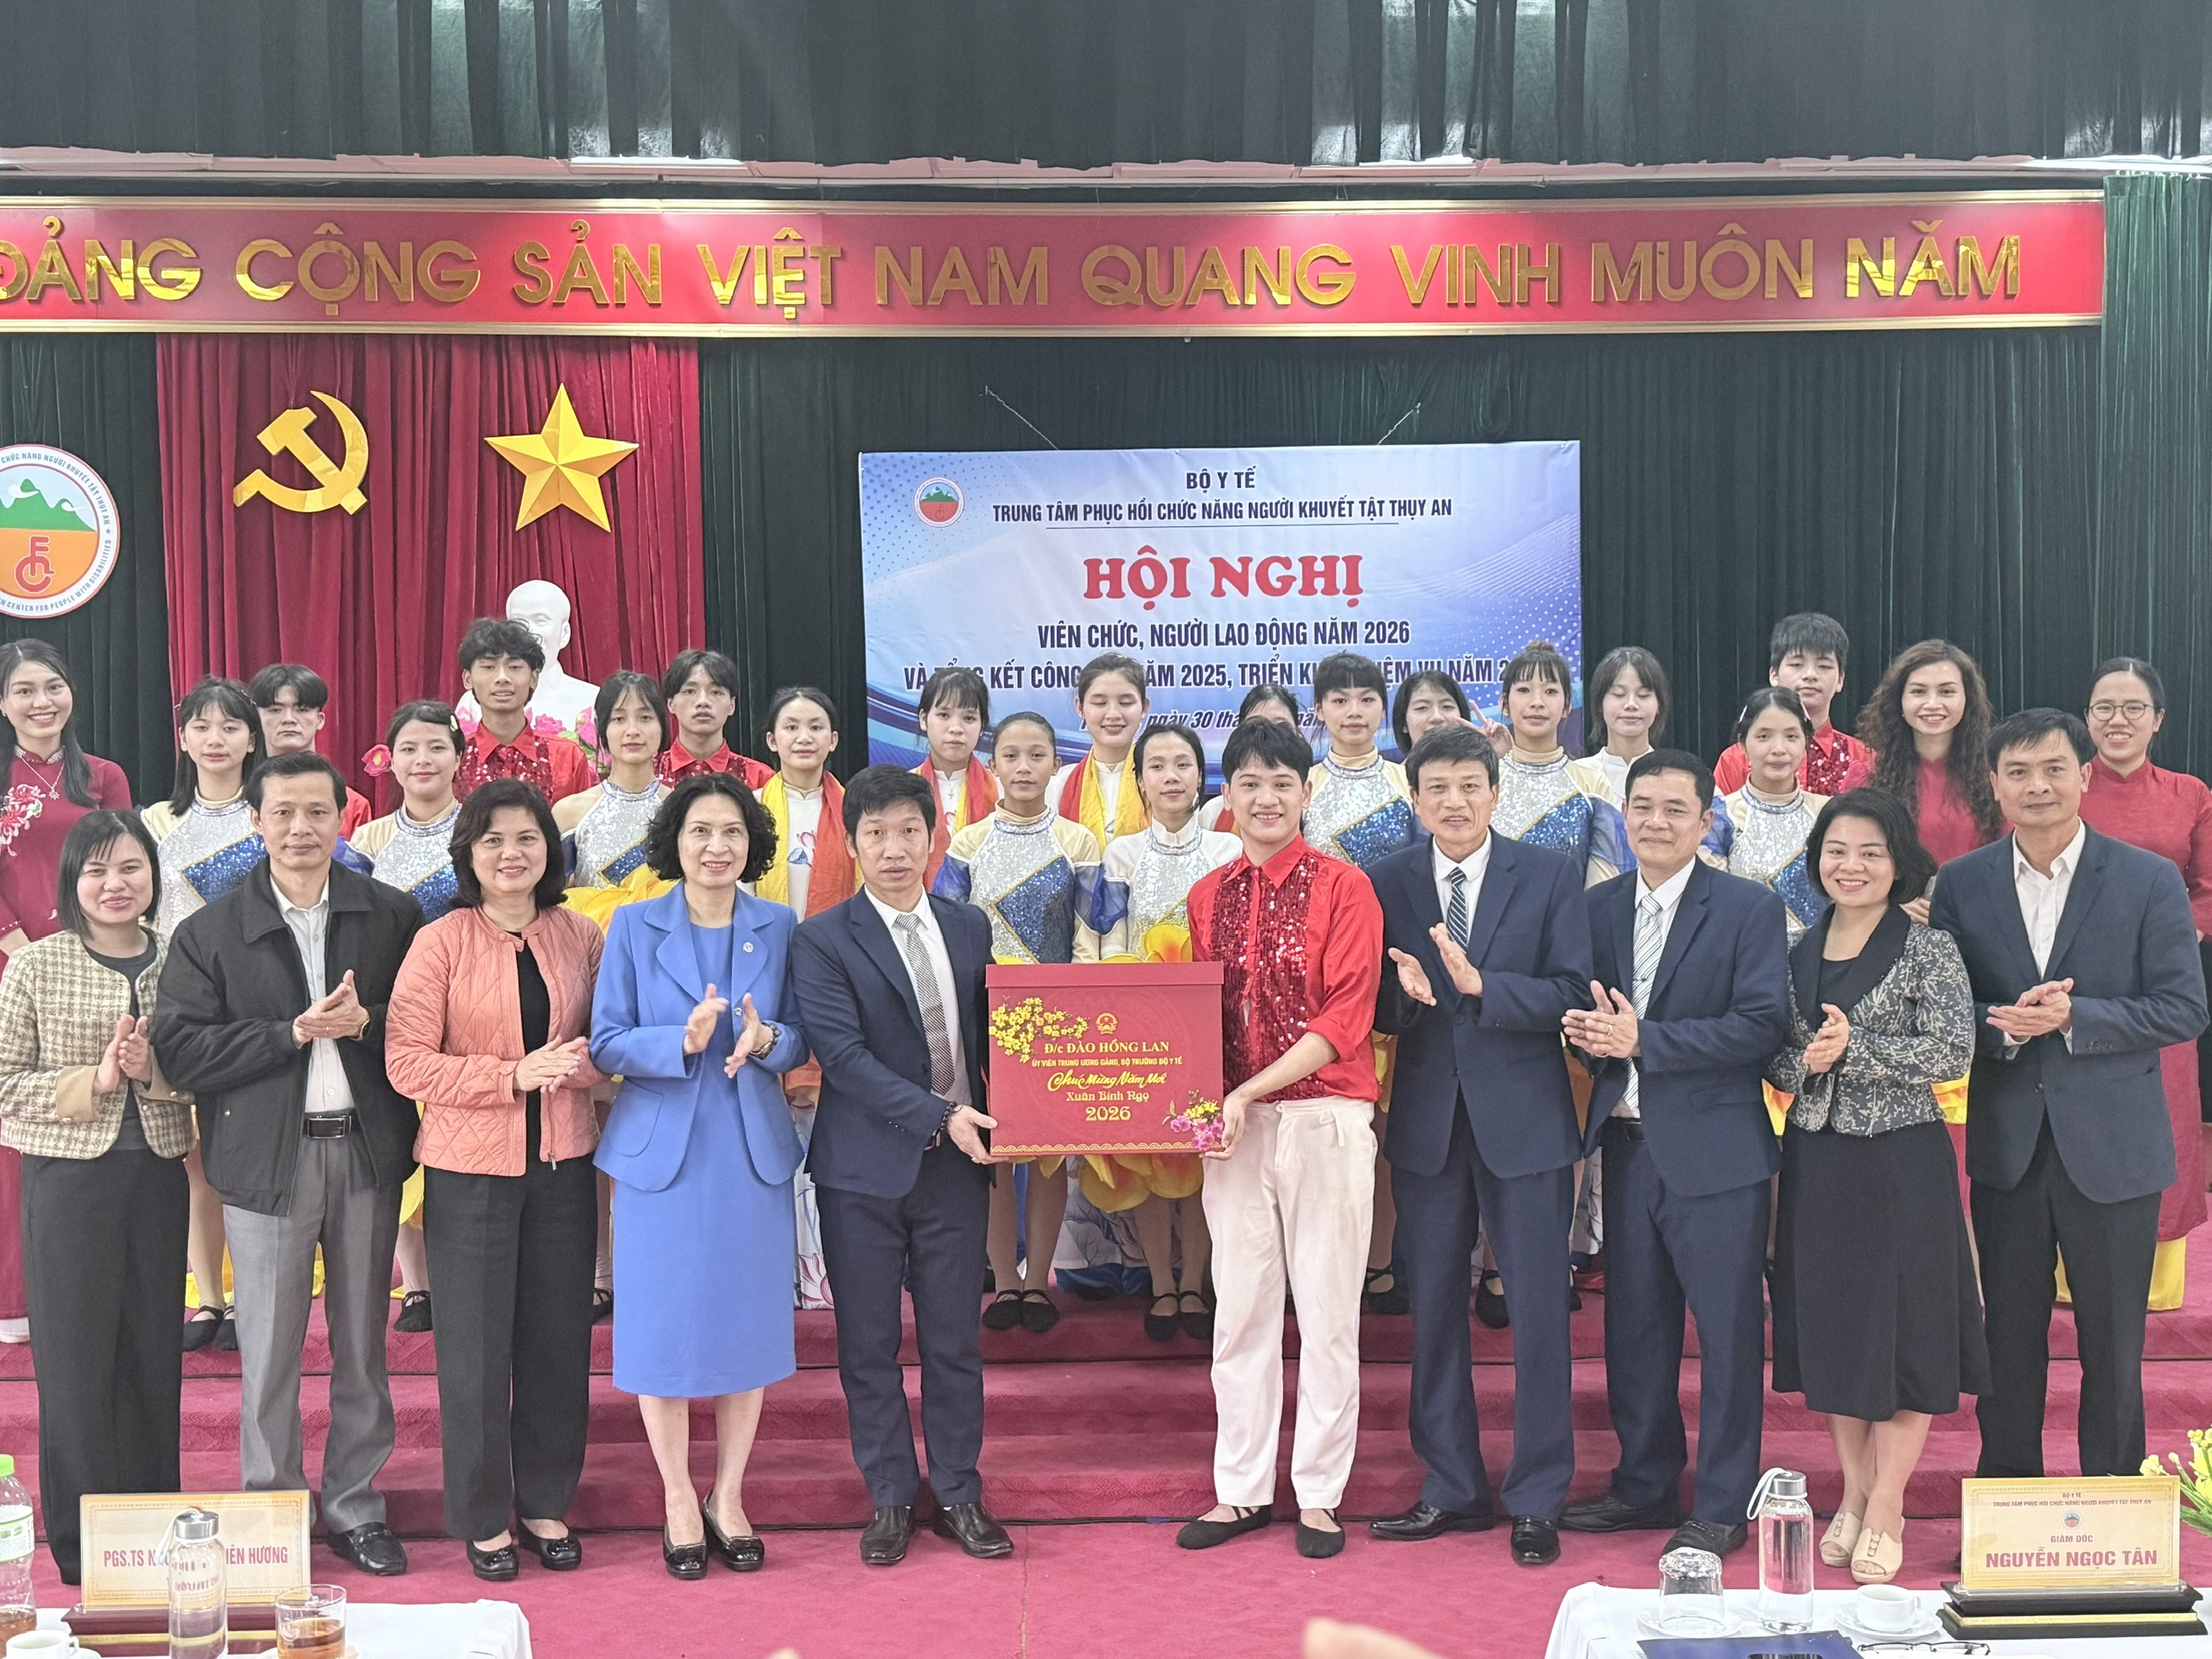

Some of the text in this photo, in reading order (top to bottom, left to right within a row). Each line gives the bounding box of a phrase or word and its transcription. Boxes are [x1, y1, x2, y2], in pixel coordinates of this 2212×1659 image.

[236, 222, 482, 316] CỘNG
[514, 219, 663, 305] SẢN
[696, 226, 842, 320] VIỆT
[874, 245, 1048, 307] NAM
[1081, 245, 1356, 308] QUANG
[1391, 243, 1559, 306] VINH
[1592, 222, 1814, 302] MUÔN
[1846, 219, 2021, 297] NĂM
[1185, 465, 1257, 493] BỘ Y TẾ
[102, 515, 111, 524] AN
[993, 495, 1452, 524] TRUNG TÂM PHỤC HỒI CHỨC NĂNG NGƯỜI KHUYẾT TẬT THỤY AN
[1084, 544, 1364, 611] HỘI NGHỊ
[50, 594, 75, 609] PEOPLE
[1038, 617, 1410, 651] VIÊN CHỨC, NGƯỜI LAO ĐỘNG NĂM 2026
[904, 663, 927, 690] VÀ
[991, 659, 1025, 689] KẾT
[1143, 660, 1175, 687] ĂM
[1181, 664, 1232, 689] 2025,
[1238, 654, 1294, 686] TRIỂN
[1449, 654, 1493, 683] NĂM
[1191, 711, 1214, 728] 30
[1045, 1039, 1170, 1054] Đ/c ĐÀO HỒNG LAN
[1047, 1069, 1090, 1091] Chúc
[1116, 1071, 1146, 1089] Năm
[1066, 1090, 1150, 1103] Xuân Bính Ngọ
[1085, 1106, 1131, 1122] 2026
[104, 1549, 143, 1567] PGS.TS
[249, 1545, 288, 1564] HƯƠNG
[1986, 1547, 2158, 1569] NGUYỄN NGỌC TÂN
